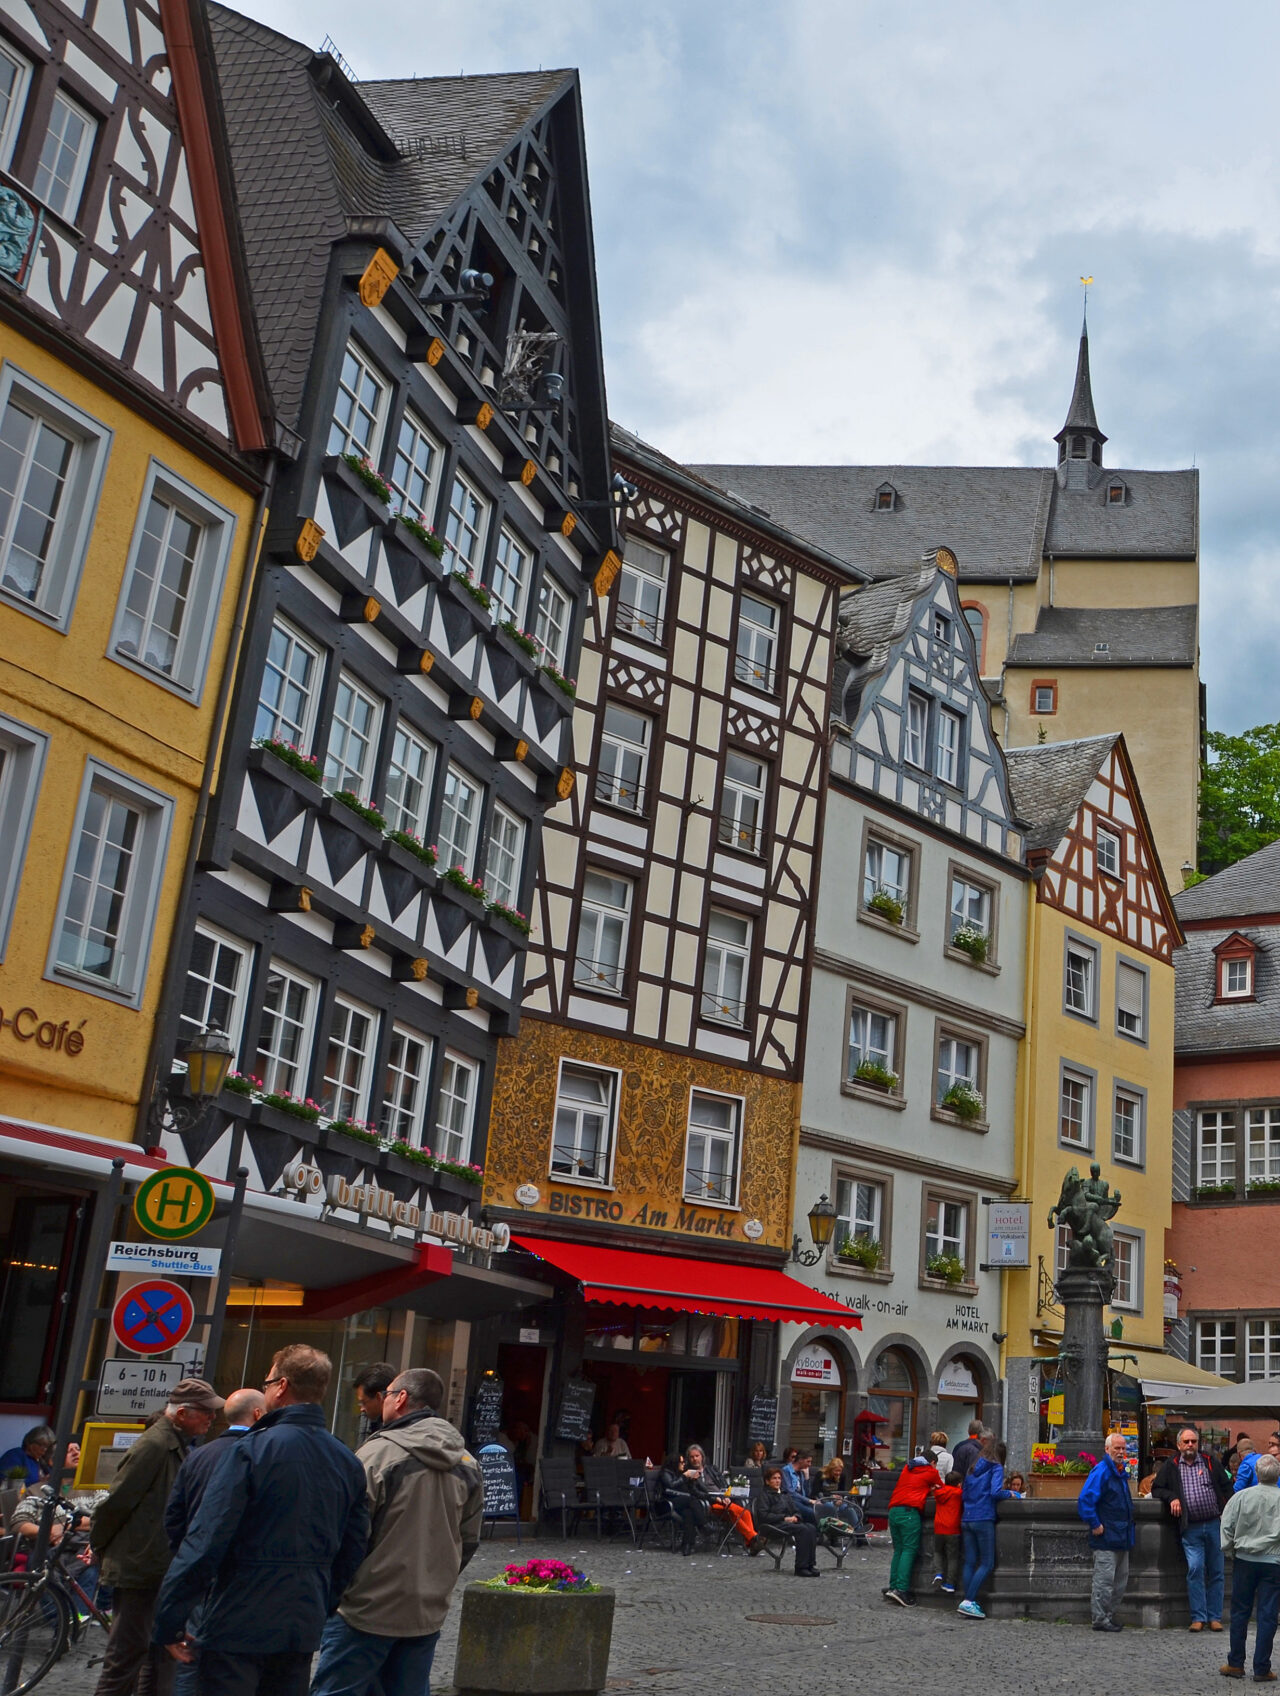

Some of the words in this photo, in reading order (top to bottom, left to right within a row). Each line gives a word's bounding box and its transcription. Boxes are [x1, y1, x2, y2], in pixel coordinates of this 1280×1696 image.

[0, 1006, 88, 1057] -Café
[157, 1182, 193, 1223] H
[328, 1174, 420, 1228] brillen
[424, 1211, 495, 1250] müller
[550, 1191, 624, 1222] BISTRO
[631, 1202, 668, 1227] Am
[674, 1207, 736, 1237] Markt
[114, 1244, 199, 1262] Reichsburg
[151, 1260, 213, 1272] Shuttle-Bus
[845, 1294, 909, 1317] walk-on-air
[955, 1304, 980, 1319] HOTEL
[946, 1318, 959, 1330] AM
[961, 1319, 989, 1334] MARKT
[796, 1357, 823, 1369] kyBoot
[119, 1367, 126, 1380] 6
[144, 1369, 156, 1382] 10
[160, 1369, 167, 1382] h
[104, 1386, 119, 1396] Be-
[122, 1387, 138, 1396] und
[140, 1388, 172, 1398] Entlade
[131, 1400, 146, 1409] frei
